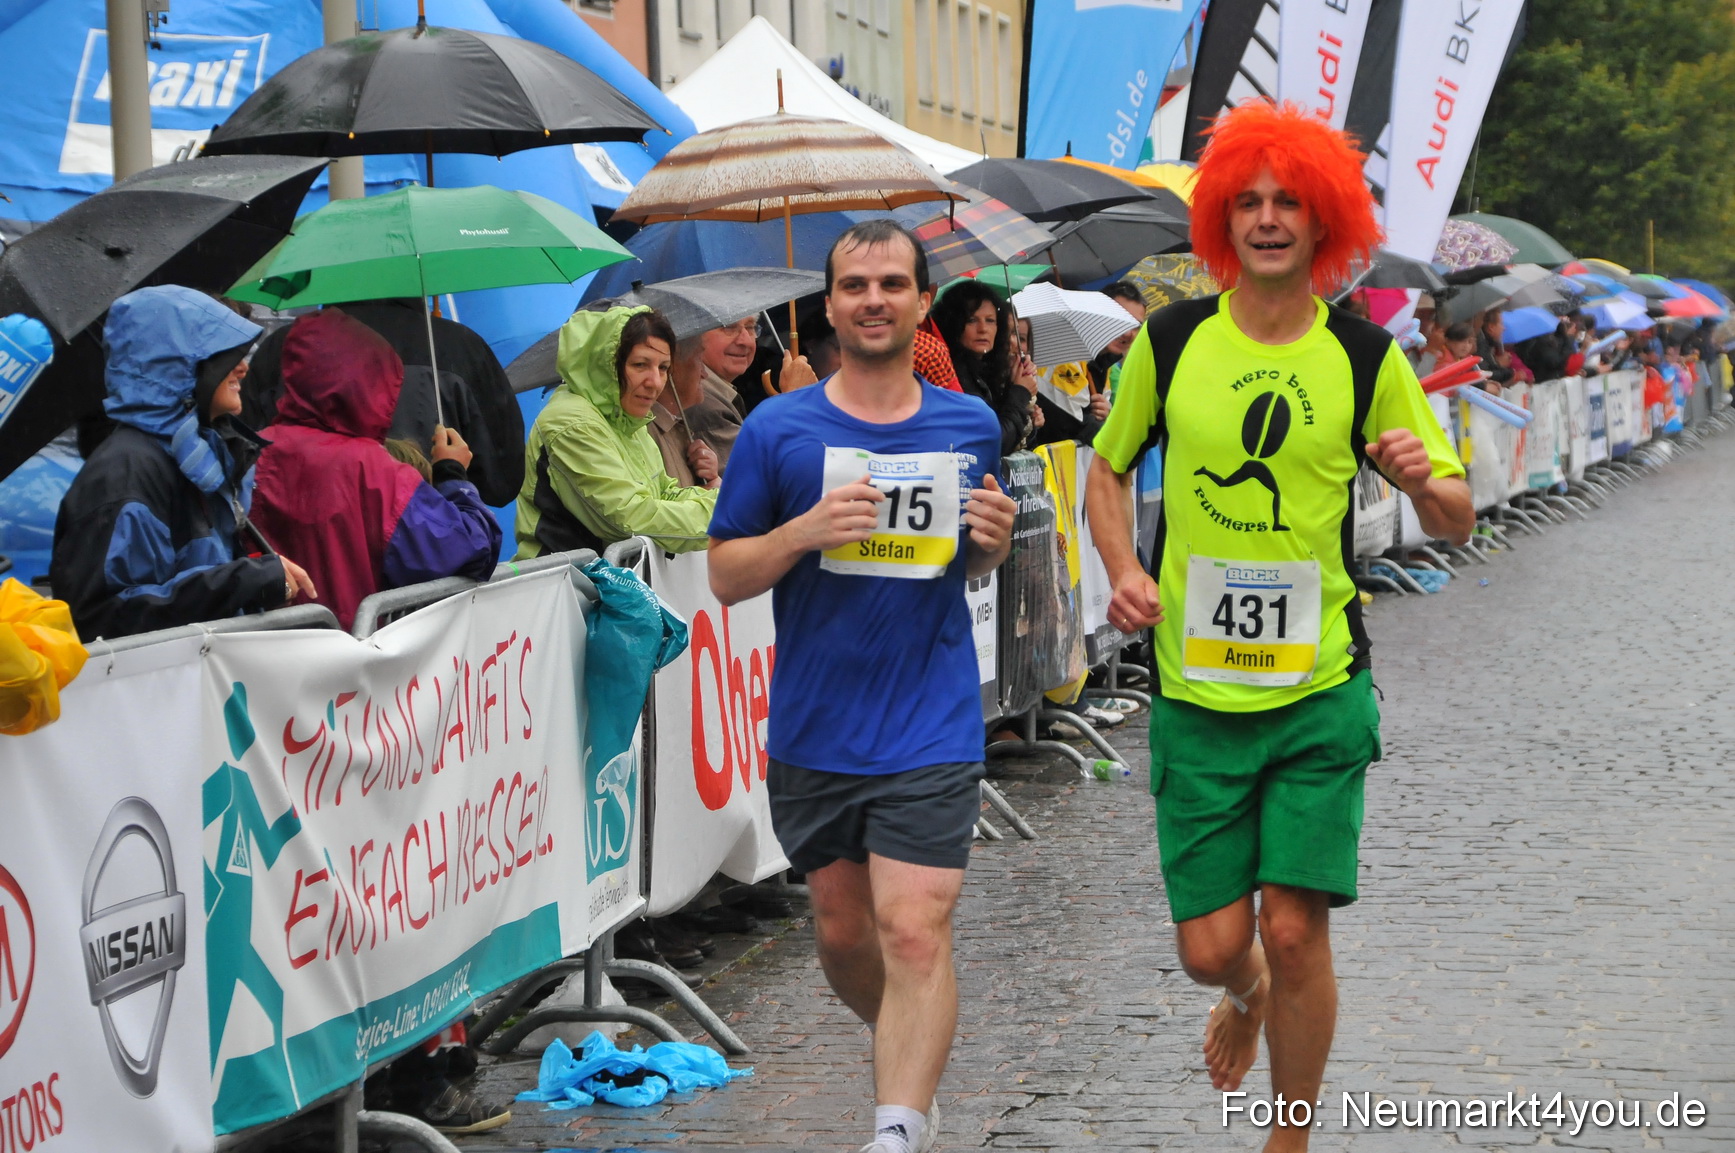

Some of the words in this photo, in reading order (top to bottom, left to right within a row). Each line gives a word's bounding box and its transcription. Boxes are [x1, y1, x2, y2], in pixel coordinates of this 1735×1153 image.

[1316, 30, 1343, 120] udi
[1416, 76, 1460, 191] Audi
[1446, 0, 1482, 65] BK
[1107, 69, 1149, 166] -dsl.de
[0, 350, 31, 384] axi
[1230, 369, 1281, 392] nero
[1286, 373, 1315, 426] bean
[868, 460, 919, 473] BOCK
[858, 484, 933, 532] 15
[1194, 486, 1269, 532] runners
[859, 540, 915, 559] Stefan
[1226, 567, 1280, 581] BOCK
[1212, 593, 1288, 639] 431
[1224, 647, 1275, 667] Armin
[362, 674, 424, 797] UNS
[455, 765, 553, 906] BESSER.
[88, 913, 174, 986] NISSAN
[0, 1072, 64, 1153] TORS
